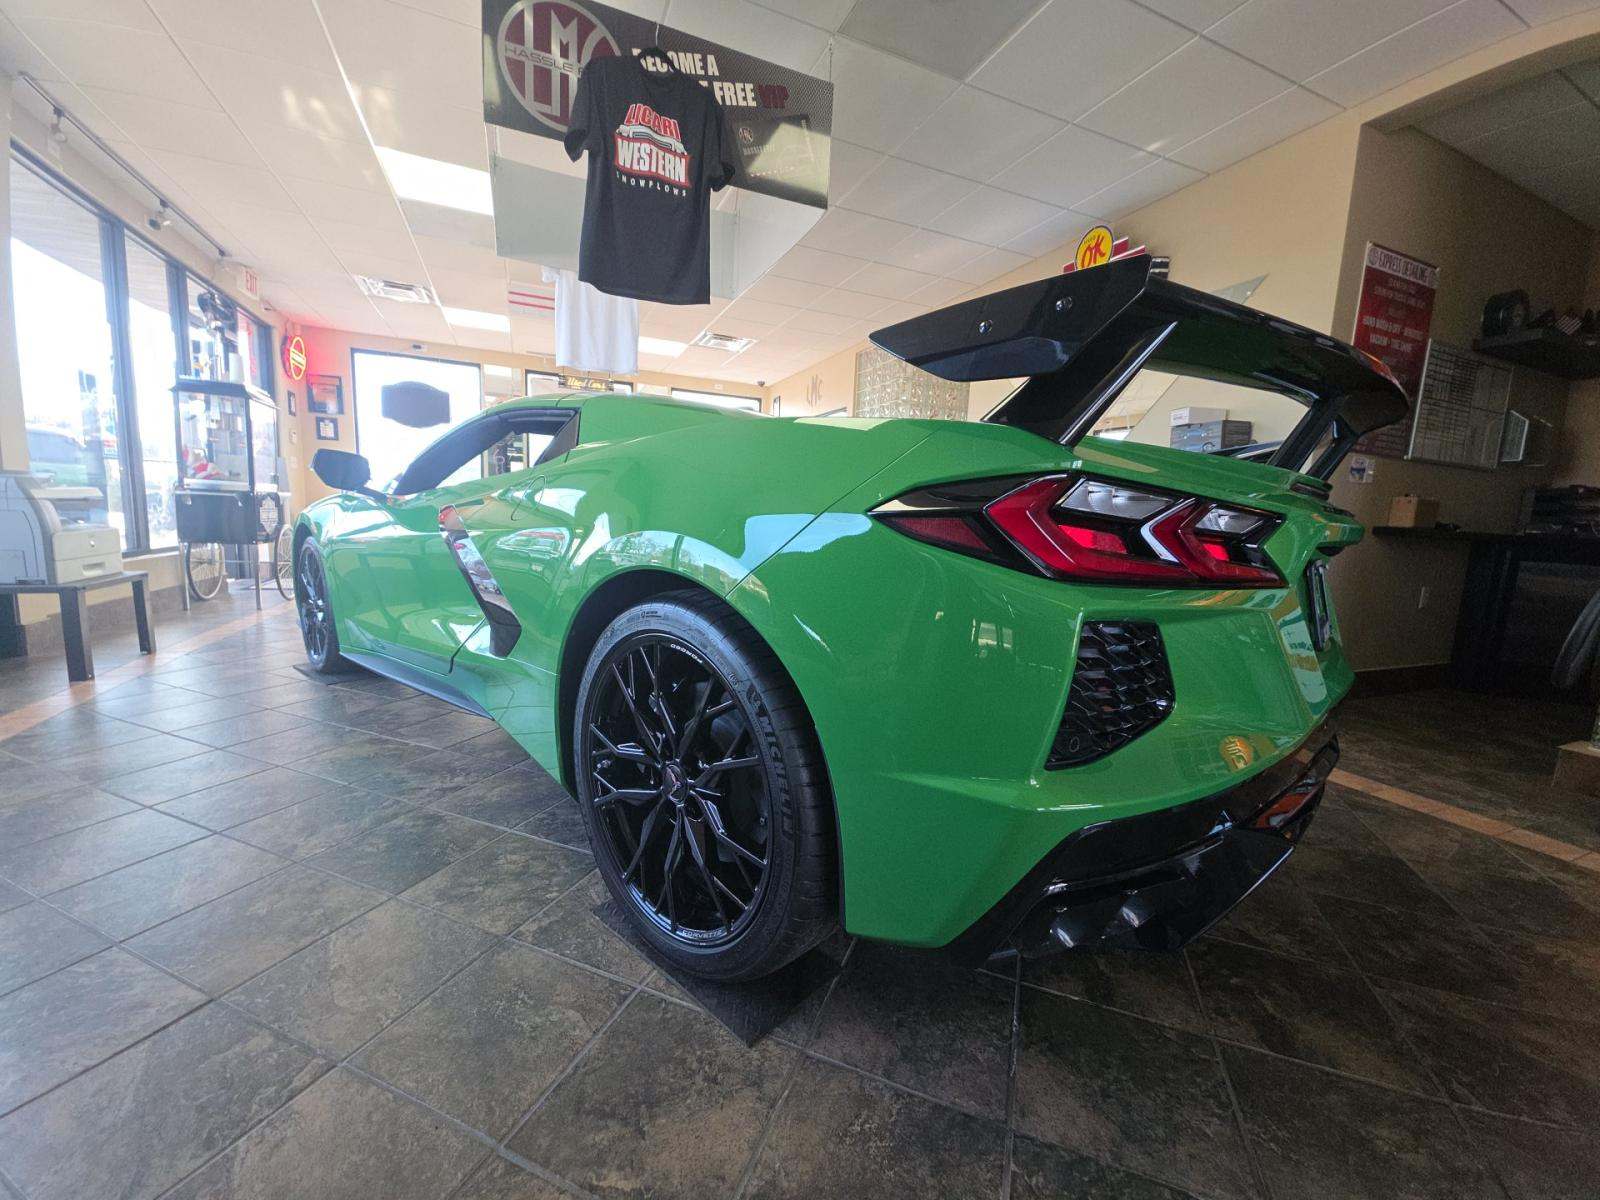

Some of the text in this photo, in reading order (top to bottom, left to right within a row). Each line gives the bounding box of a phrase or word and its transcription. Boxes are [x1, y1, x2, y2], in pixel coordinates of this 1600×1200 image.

[706, 54, 720, 77] A
[713, 81, 757, 107] FREE
[624, 104, 682, 142] LICARI
[617, 139, 686, 183] WESTERN
[616, 171, 687, 197] SNOWPLOWS
[1081, 234, 1107, 269] OK
[245, 270, 257, 294] EXIT
[759, 716, 793, 834] MICHELIN
[682, 929, 722, 939] CORVETTE
